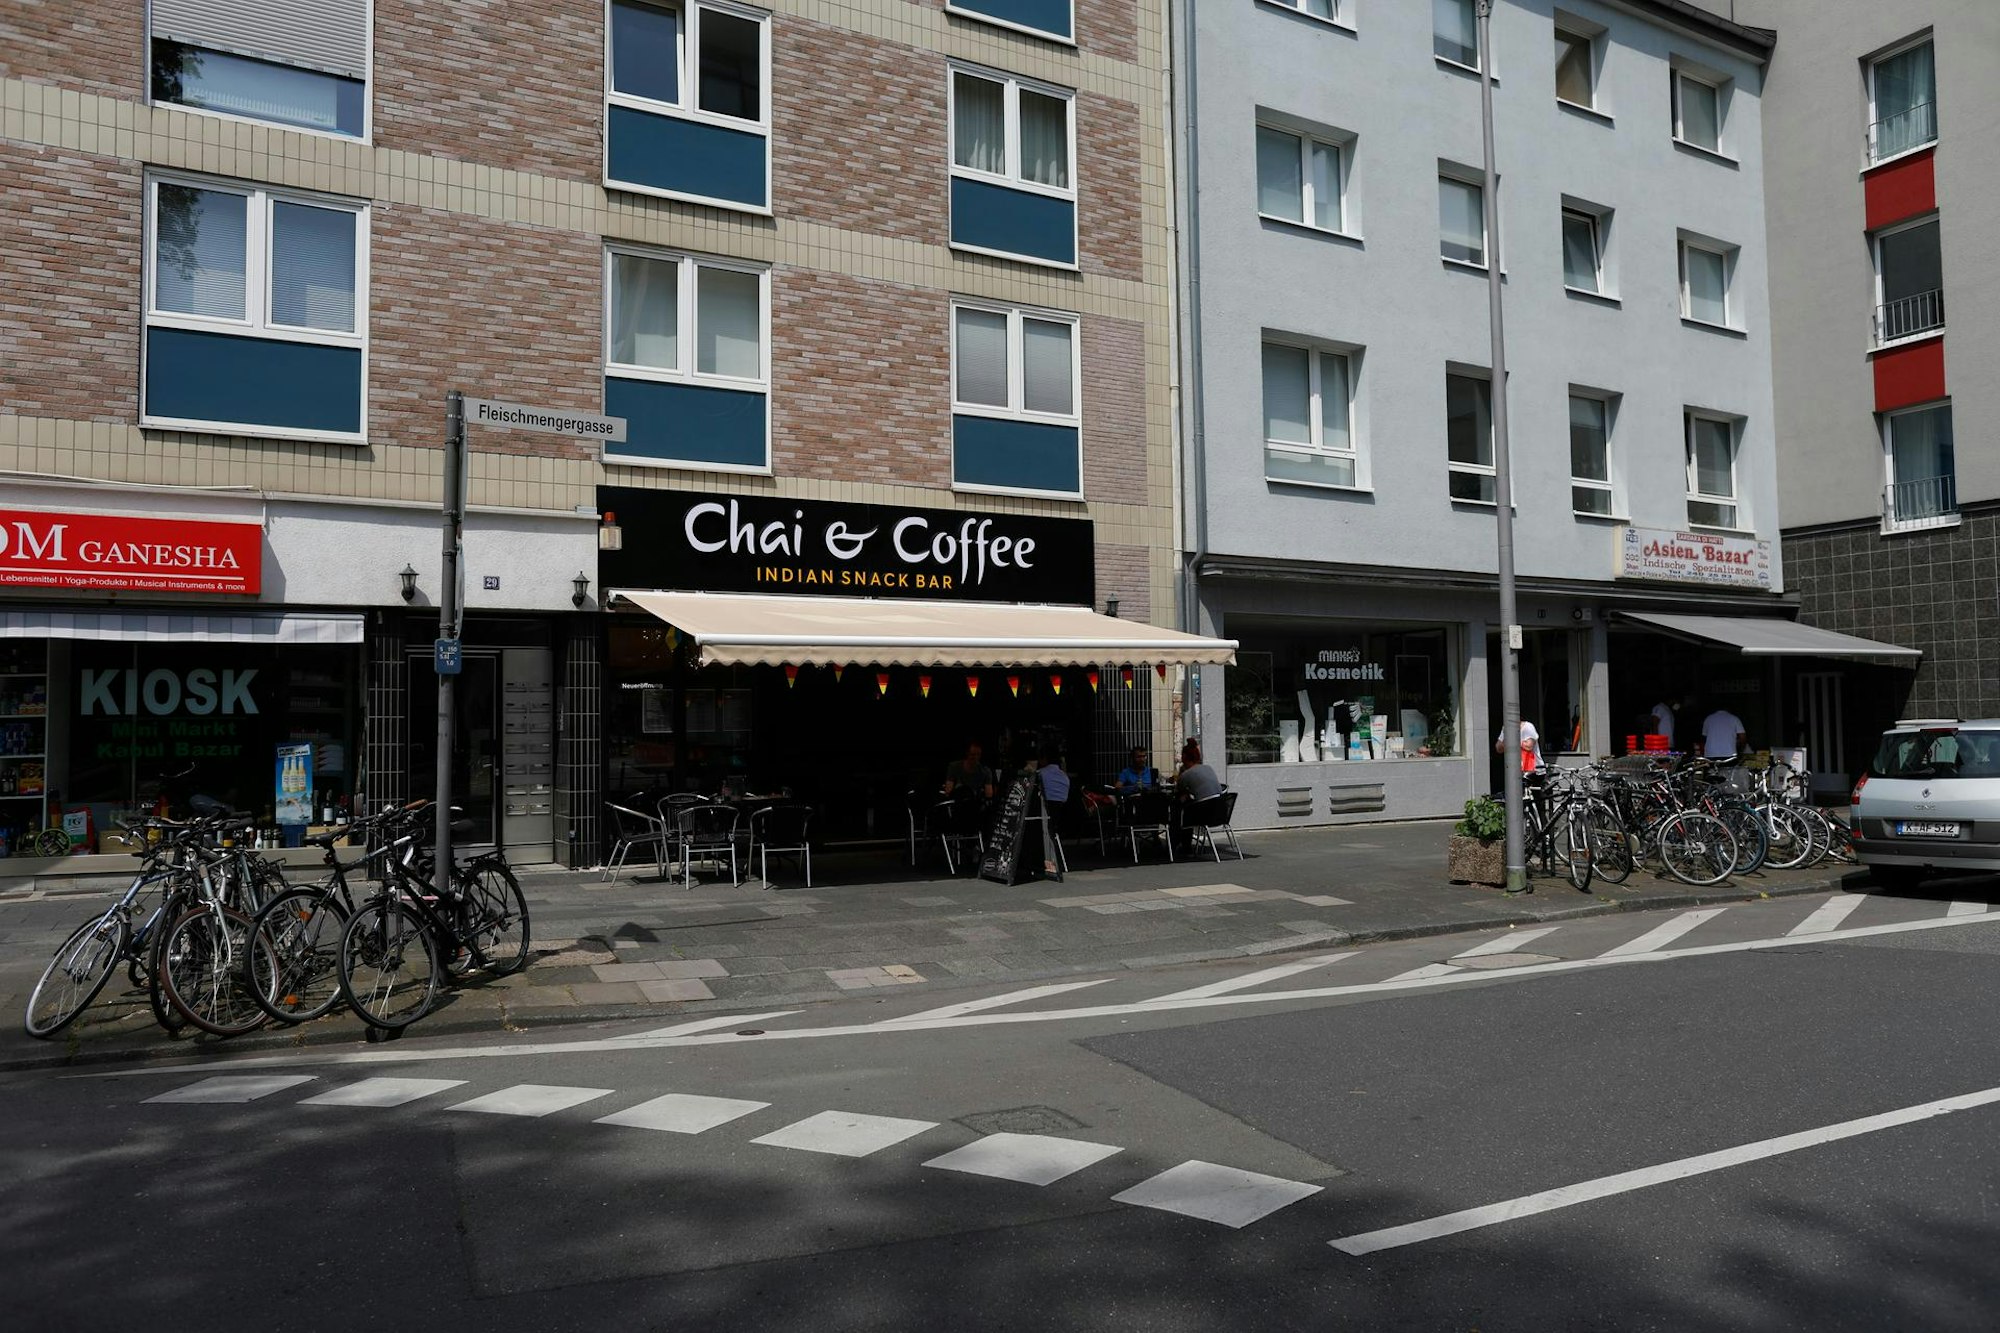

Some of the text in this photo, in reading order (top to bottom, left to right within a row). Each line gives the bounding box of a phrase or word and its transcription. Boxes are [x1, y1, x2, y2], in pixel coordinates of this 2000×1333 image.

[478, 403, 614, 434] Fleischmengergasse
[0, 521, 240, 569] M GANESHA
[684, 499, 1036, 586] Chai & Coffee
[1643, 540, 1699, 561] Asien
[1702, 545, 1754, 564] Bazar
[1643, 558, 1686, 570] Indische
[0, 574, 58, 584] Lebensmittel
[65, 577, 128, 586] Yoga-Produkte
[135, 579, 167, 588] Musical
[168, 581, 215, 590] Instruments
[756, 566, 953, 590] INDIAN SNACK BAR
[1305, 662, 1385, 680] Kosmetik
[80, 667, 261, 717] KIOSK
[168, 721, 238, 738] Markt
[97, 741, 244, 759] Kabul Bazar
[1906, 821, 1955, 834] K AF 512
